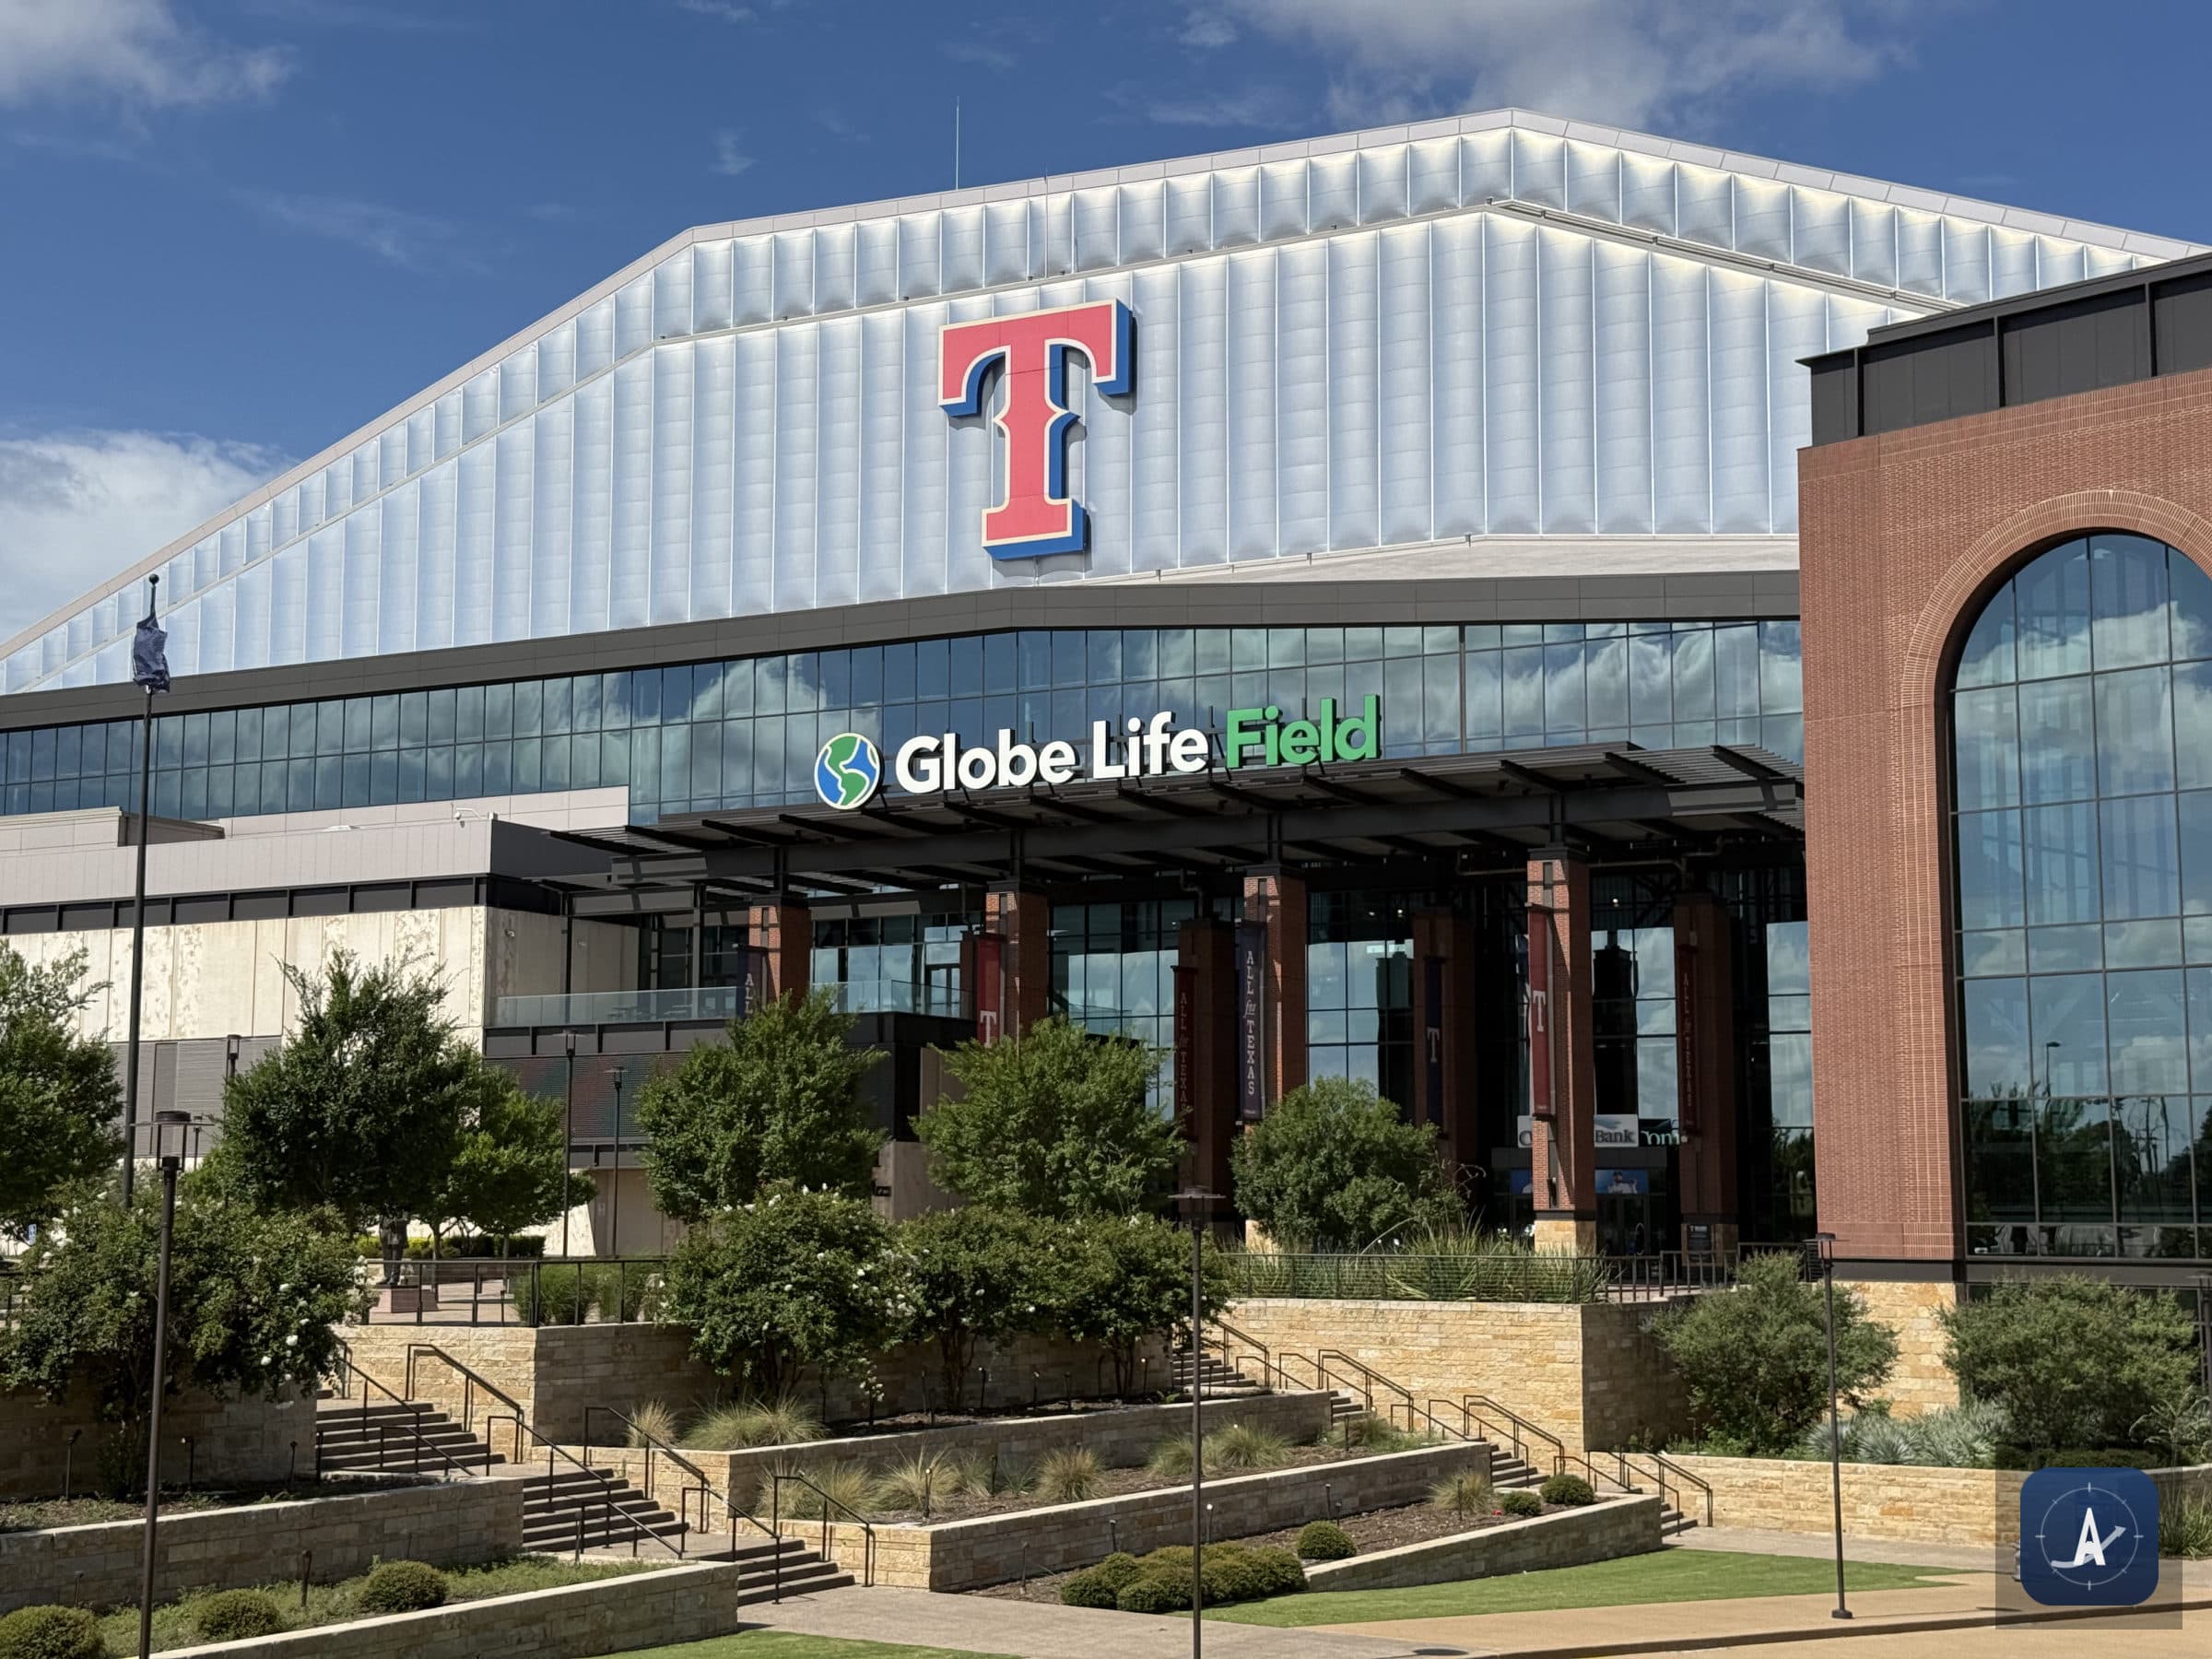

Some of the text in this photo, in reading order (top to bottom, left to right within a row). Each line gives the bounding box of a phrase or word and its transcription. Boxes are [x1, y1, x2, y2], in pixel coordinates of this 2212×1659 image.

[938, 298, 1133, 560] T
[895, 693, 1382, 794] Globe Life Field
[1246, 950, 1254, 994] ALL
[980, 1010, 997, 1048] T
[1180, 992, 1188, 1030] ALL
[1533, 990, 1547, 1032] T
[1246, 1019, 1255, 1095] TEXAS
[1427, 1026, 1440, 1063] T
[1180, 1051, 1188, 1106] TEXA
[1594, 1128, 1635, 1143] Bank
